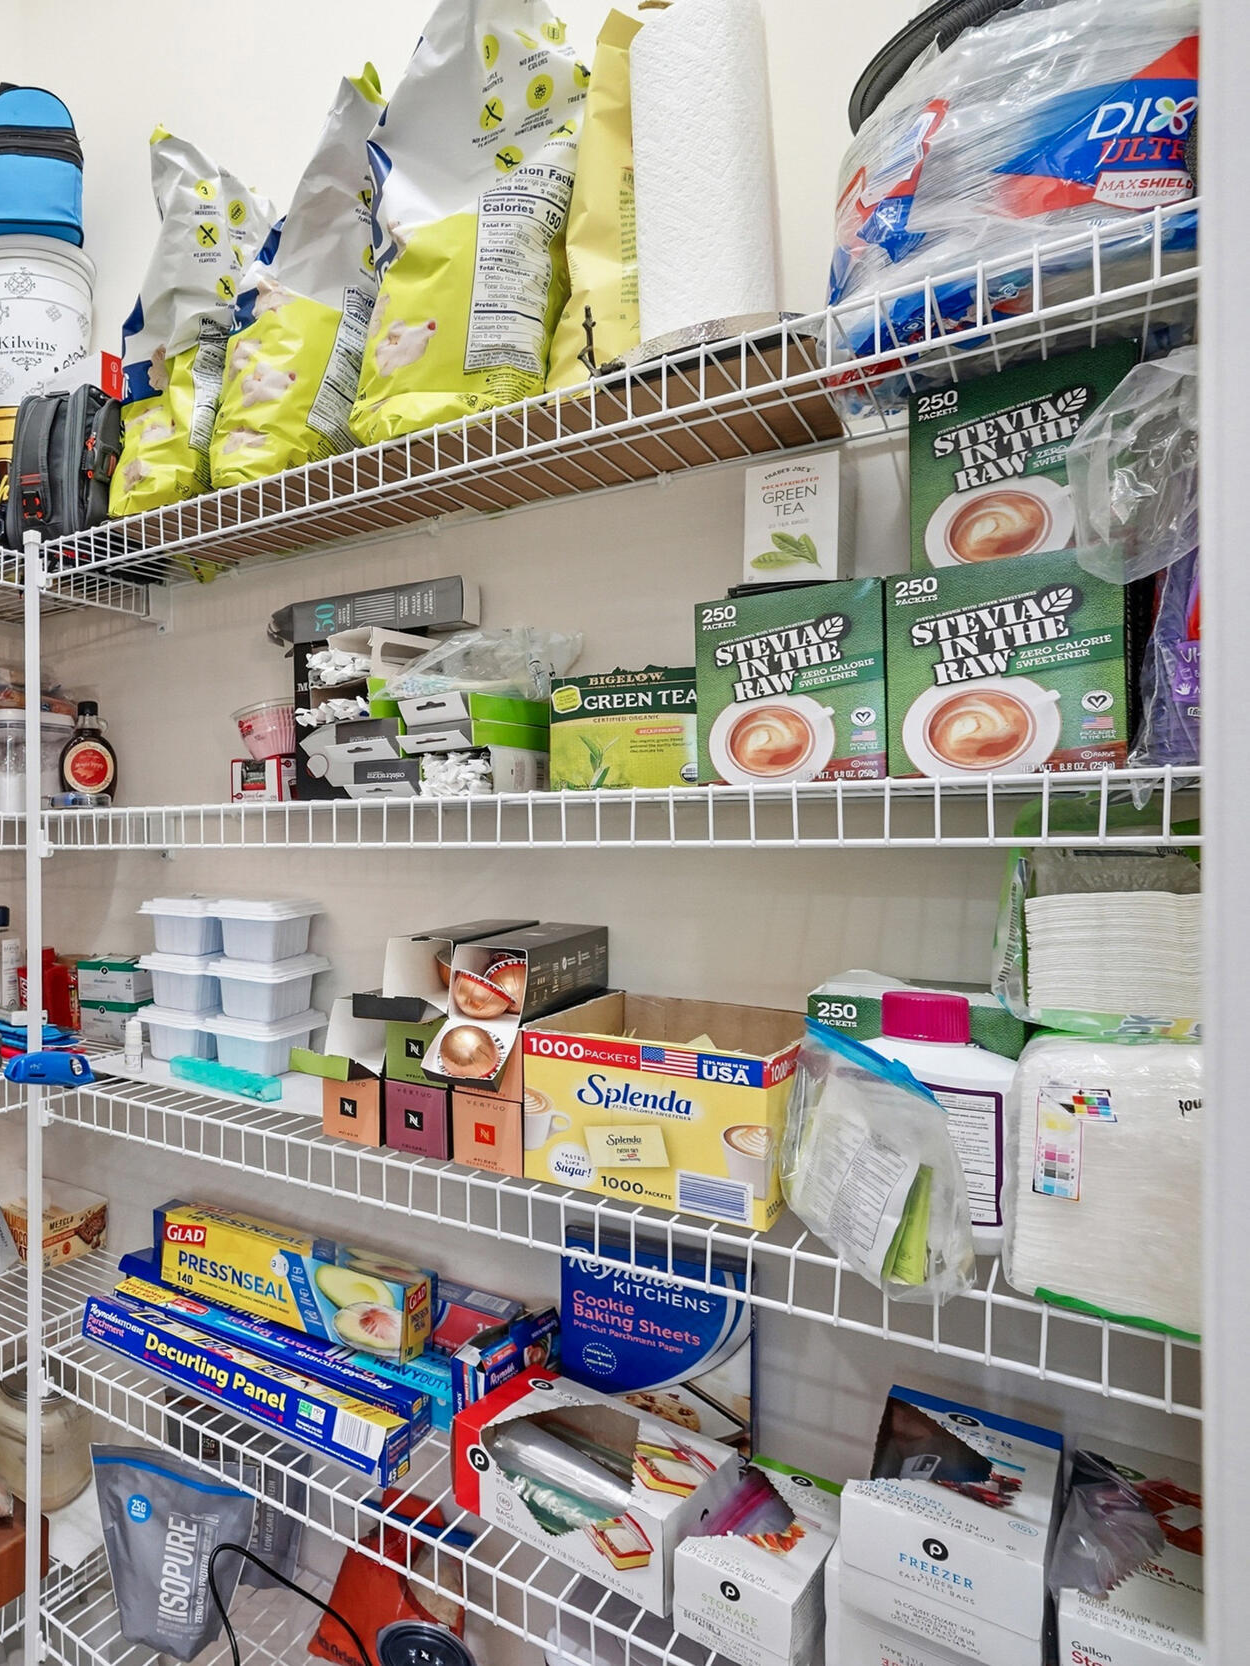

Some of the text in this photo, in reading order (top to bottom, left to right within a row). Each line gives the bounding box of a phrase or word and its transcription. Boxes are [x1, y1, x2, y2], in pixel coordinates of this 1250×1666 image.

[1087, 97, 1198, 141] DIX
[1100, 136, 1186, 164] ULTR
[548, 165, 574, 189] Facts
[482, 203, 562, 230] Calories 150
[917, 390, 959, 414] 250
[917, 406, 959, 423] PACKETS
[933, 402, 1060, 458] STEVIA
[959, 413, 1082, 470] IN THE
[954, 452, 1031, 493] RAW
[762, 484, 817, 505] GREEN
[774, 502, 805, 517] TEA
[895, 577, 938, 599] 250
[895, 594, 938, 606] PACKETS
[701, 605, 737, 624] 250
[701, 621, 737, 631] PACKETS
[911, 598, 1042, 647] STEVIA
[714, 626, 820, 667] STEVIA
[939, 615, 1070, 662] IN THE
[1020, 634, 1113, 660] ZERO CALORIE
[737, 640, 842, 681] IN THE
[801, 658, 876, 680] ZERO CALORIE
[933, 649, 1011, 685] RAW
[1015, 648, 1091, 670] SWEETENER
[588, 671, 664, 686] BIGELOW
[733, 671, 795, 702] RAW
[798, 670, 859, 688] SWEETENER
[583, 689, 697, 710] GREEN TEA
[1060, 762, 1088, 772] 8.8 OZ.
[818, 1001, 857, 1020] 250
[818, 1017, 858, 1028] PACKETS
[529, 1037, 637, 1065] 1000 PACKETS
[702, 1064, 750, 1086] USA
[771, 1061, 788, 1081] 1000
[397, 1088, 433, 1099] VERTUO
[576, 1074, 692, 1116] Splenda
[466, 1099, 506, 1112] VERTUO
[605, 1133, 642, 1146] Splenda
[554, 1161, 592, 1179] Sugar!
[601, 1175, 672, 1201] 1000 PACKETS
[49, 1215, 74, 1230] MEZCLA
[166, 1224, 206, 1243] GLAD
[177, 1271, 193, 1285] 140
[408, 1284, 428, 1311] GLAD
[572, 1289, 635, 1317] Cookie
[612, 1280, 711, 1314] KITCHENS
[87, 1313, 125, 1338] Parchment
[90, 1303, 121, 1325] Reynolds
[573, 1303, 701, 1347] Baking Sheets
[86, 1322, 106, 1337] Paper
[573, 1319, 684, 1355] Pre-Cut Parchment Paper
[144, 1331, 287, 1412] Decurling Panel
[131, 1499, 146, 1512] 25G
[263, 1512, 275, 1552] LOW CARB
[157, 1516, 198, 1620] ISOPURE
[898, 1552, 975, 1590] FREEZER
[899, 1571, 976, 1605] EASY-FILL BAGS
[918, 1573, 953, 1590] SLIDER
[195, 1604, 204, 1624] ZERO
[701, 1592, 759, 1628] STORAGE
[1071, 1640, 1112, 1662] Gallon
